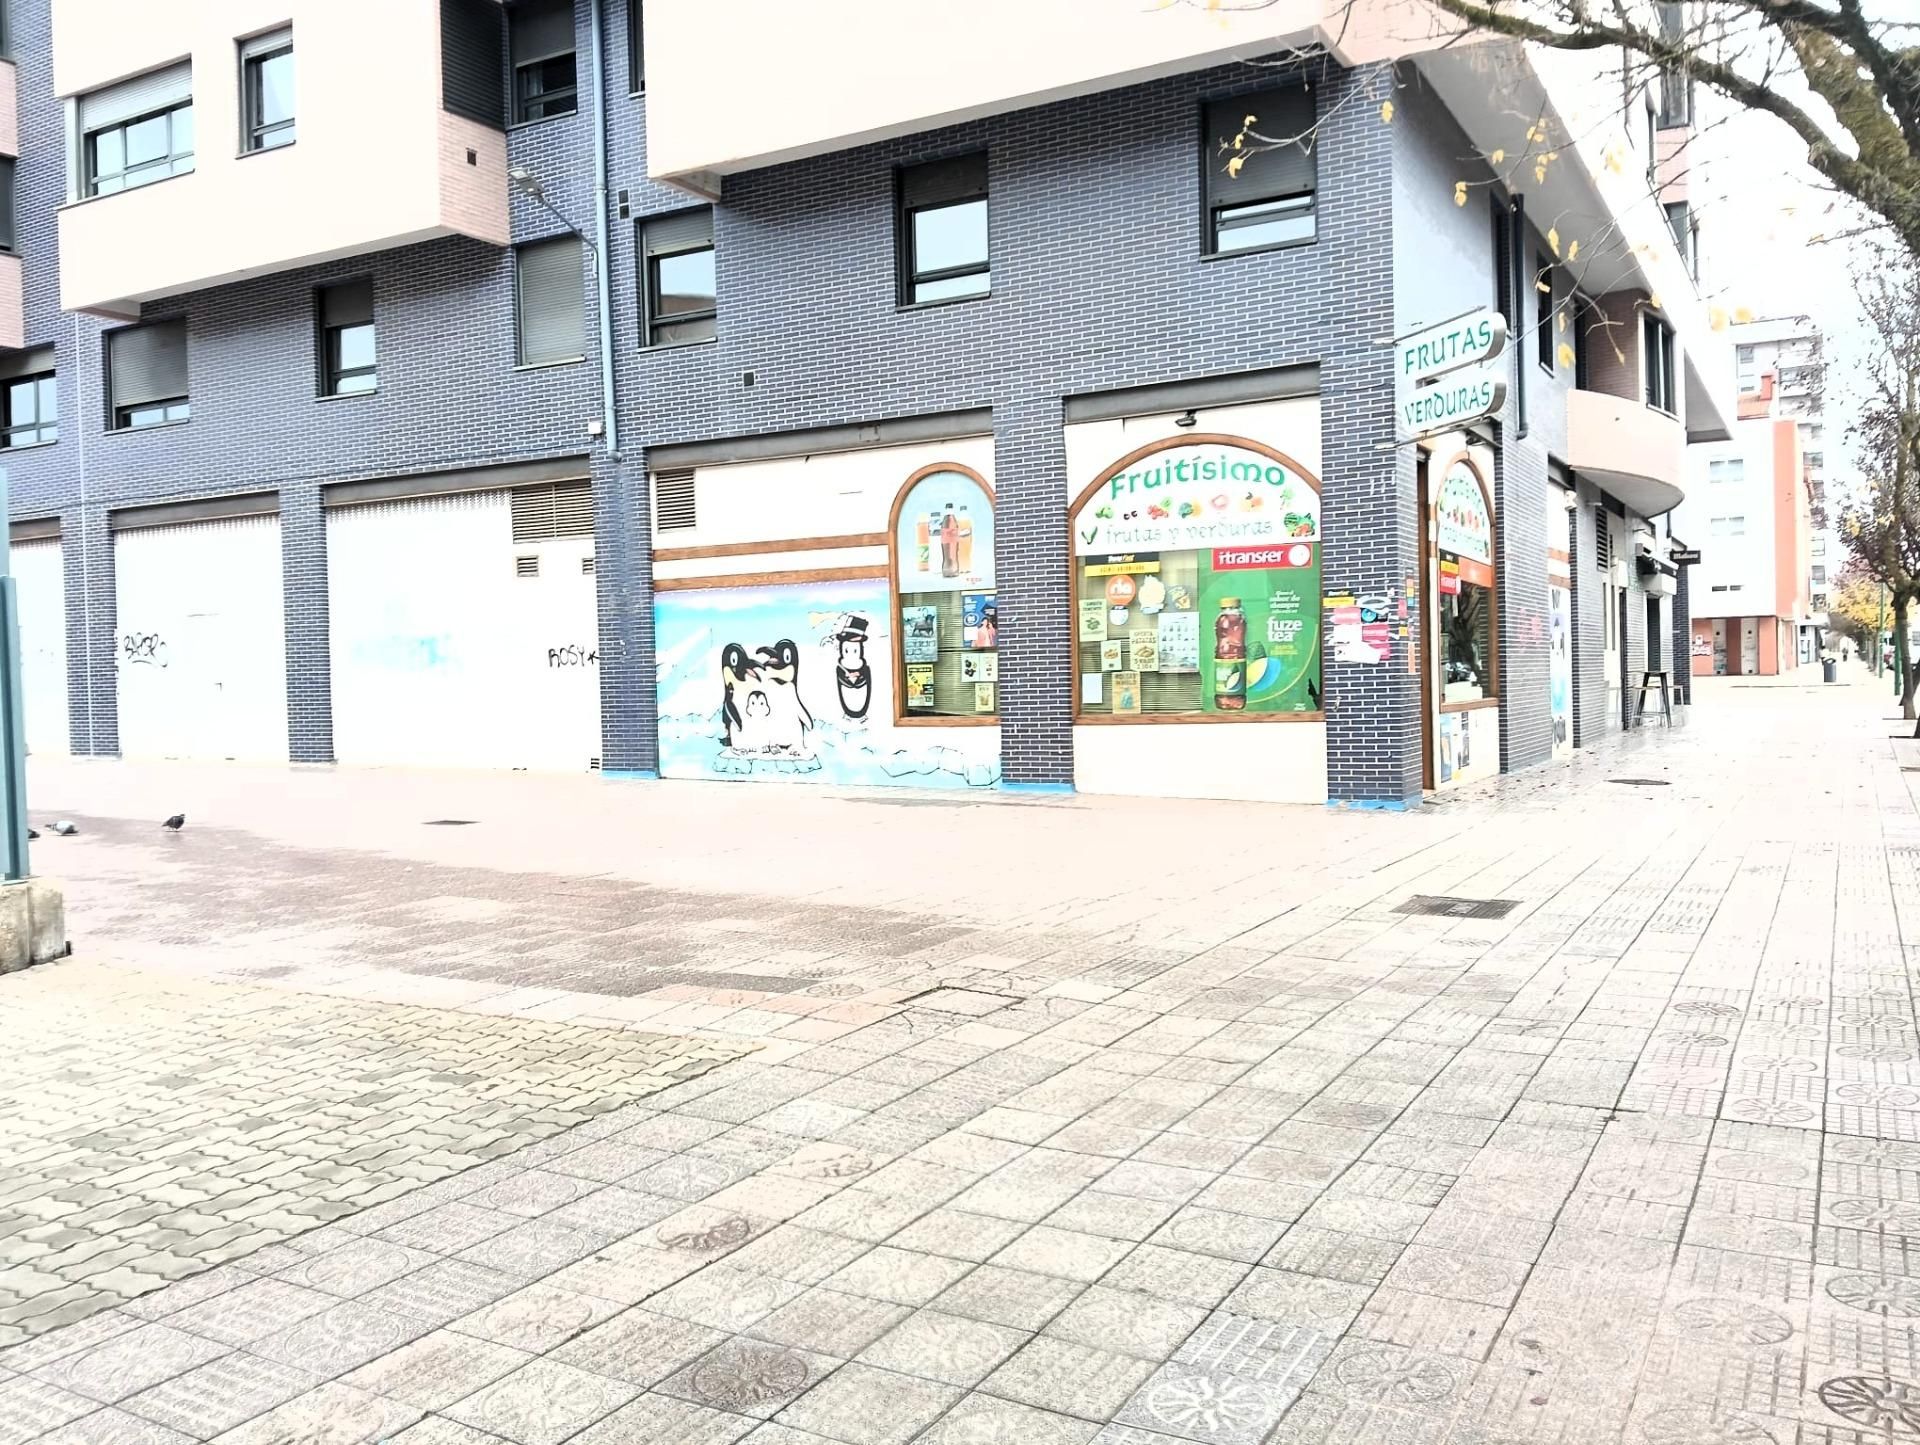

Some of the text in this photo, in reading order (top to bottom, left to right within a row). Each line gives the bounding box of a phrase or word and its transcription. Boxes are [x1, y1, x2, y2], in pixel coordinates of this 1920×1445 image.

[1405, 320, 1491, 375] FRUTAS
[1404, 381, 1490, 425] VERDURAS
[1110, 455, 1286, 500] Fruitísimo
[1106, 525, 1162, 544] frutas
[1186, 519, 1273, 540] verduras
[1266, 616, 1303, 632] fuze
[548, 644, 586, 668] ROSY
